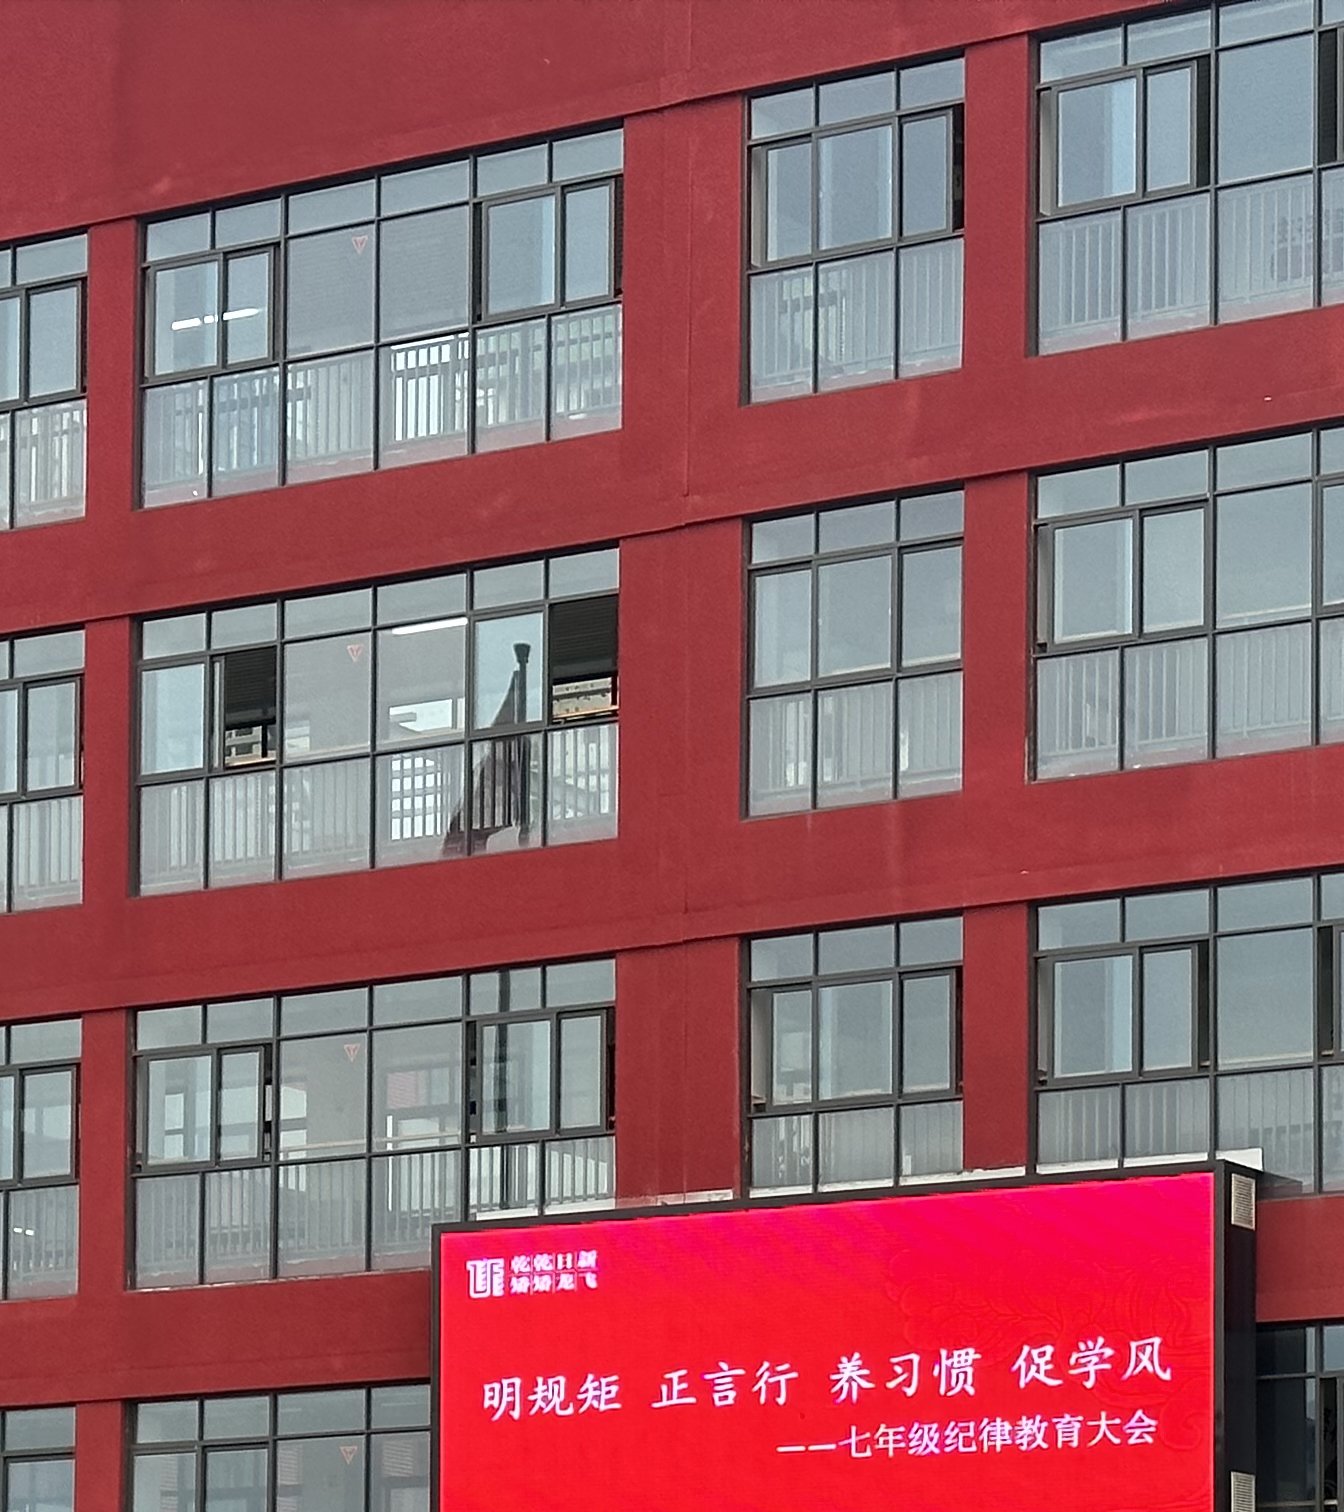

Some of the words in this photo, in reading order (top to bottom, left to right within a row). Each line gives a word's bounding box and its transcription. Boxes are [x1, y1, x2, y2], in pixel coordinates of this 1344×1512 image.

[483, 1373, 622, 1422] 明规矩
[651, 1359, 799, 1409] 正言行
[829, 1347, 982, 1402] 养习惯
[1012, 1335, 1172, 1389] 促学风
